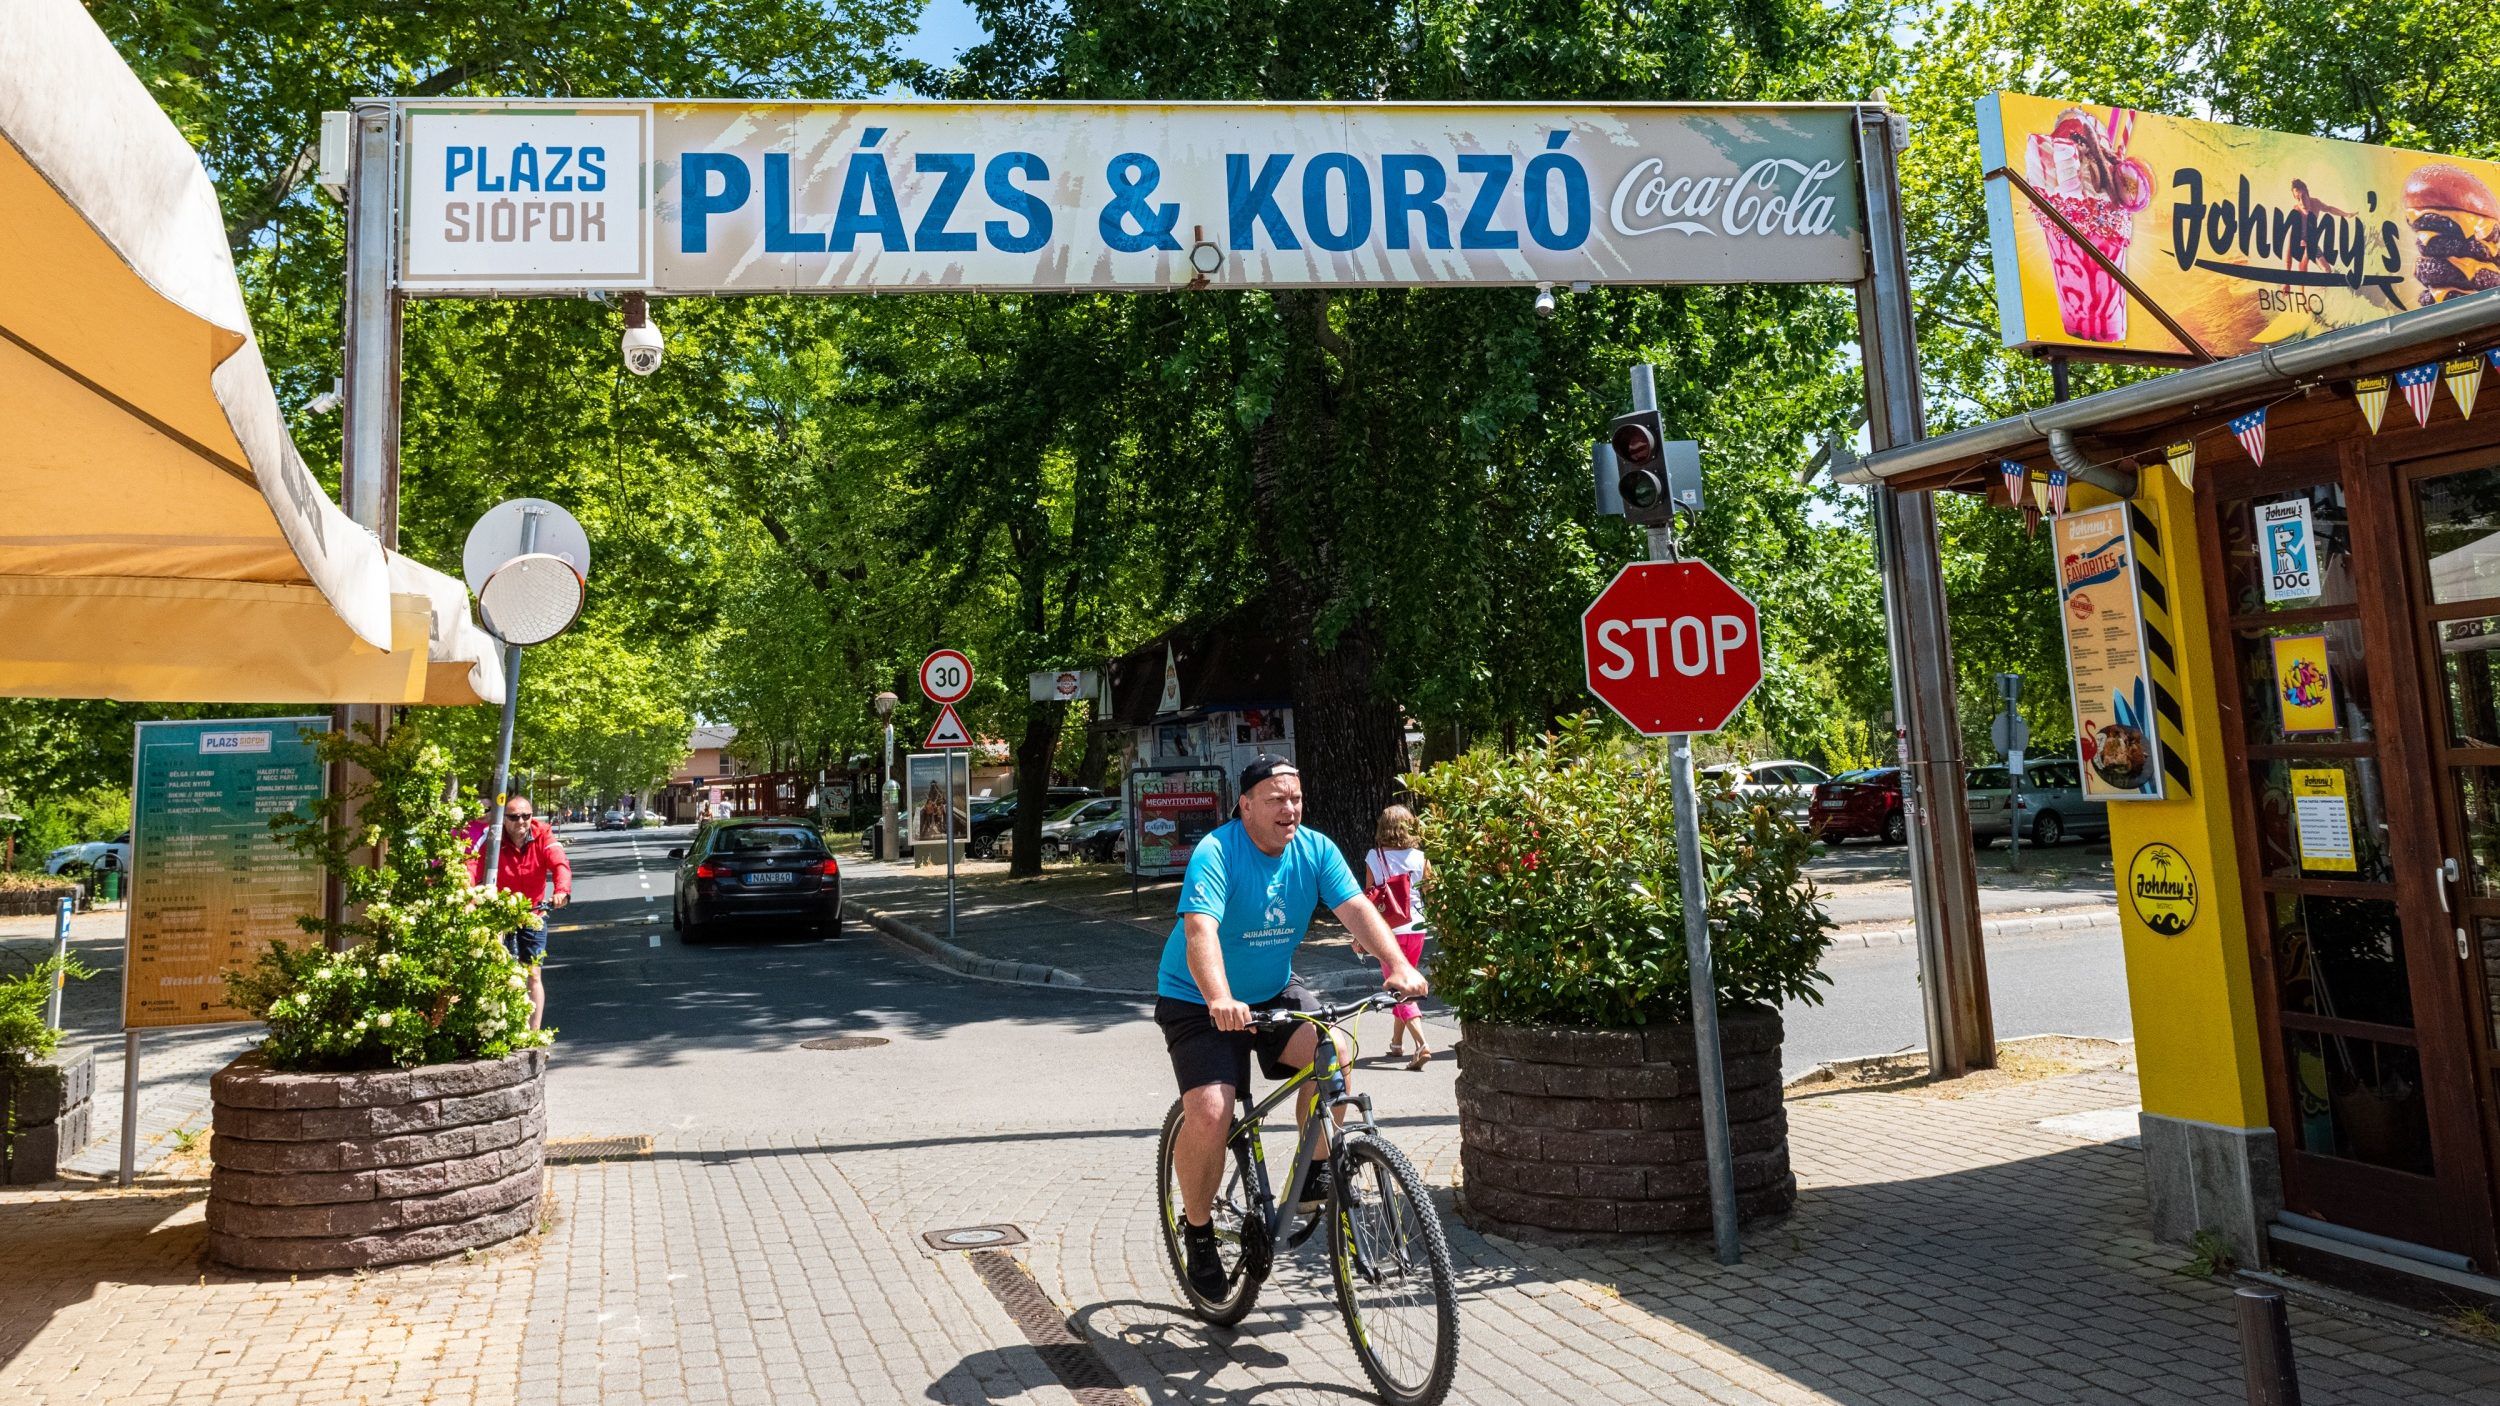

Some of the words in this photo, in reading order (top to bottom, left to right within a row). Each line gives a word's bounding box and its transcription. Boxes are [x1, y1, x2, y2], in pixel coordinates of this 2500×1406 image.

[446, 142, 606, 192] PLÁZS
[681, 128, 1053, 254] PLÁZS
[1099, 152, 1183, 253] &
[1226, 130, 1592, 252] KORZÓ
[1610, 157, 1846, 236] Coca-Cola
[444, 198, 606, 242] SIÓFOK
[2170, 167, 2403, 300] Johnny's
[2258, 288, 2324, 317] BISTRO
[2266, 501, 2302, 521] Johnny's
[2070, 514, 2113, 540] Johnny's
[2066, 553, 2116, 583] FAVORITES
[2272, 572, 2310, 590] DOG
[2274, 588, 2310, 598] FRIENDLY
[1598, 615, 1747, 680] STOP
[935, 667, 960, 688] 30
[2285, 663, 2320, 689] KIDS
[2288, 682, 2323, 705] ZONE
[1183, 782, 1214, 793] FREI
[1146, 797, 1212, 806] MEGNYITOTTUNK!
[753, 873, 792, 882] NAN-840
[2137, 874, 2193, 900] Johnny's
